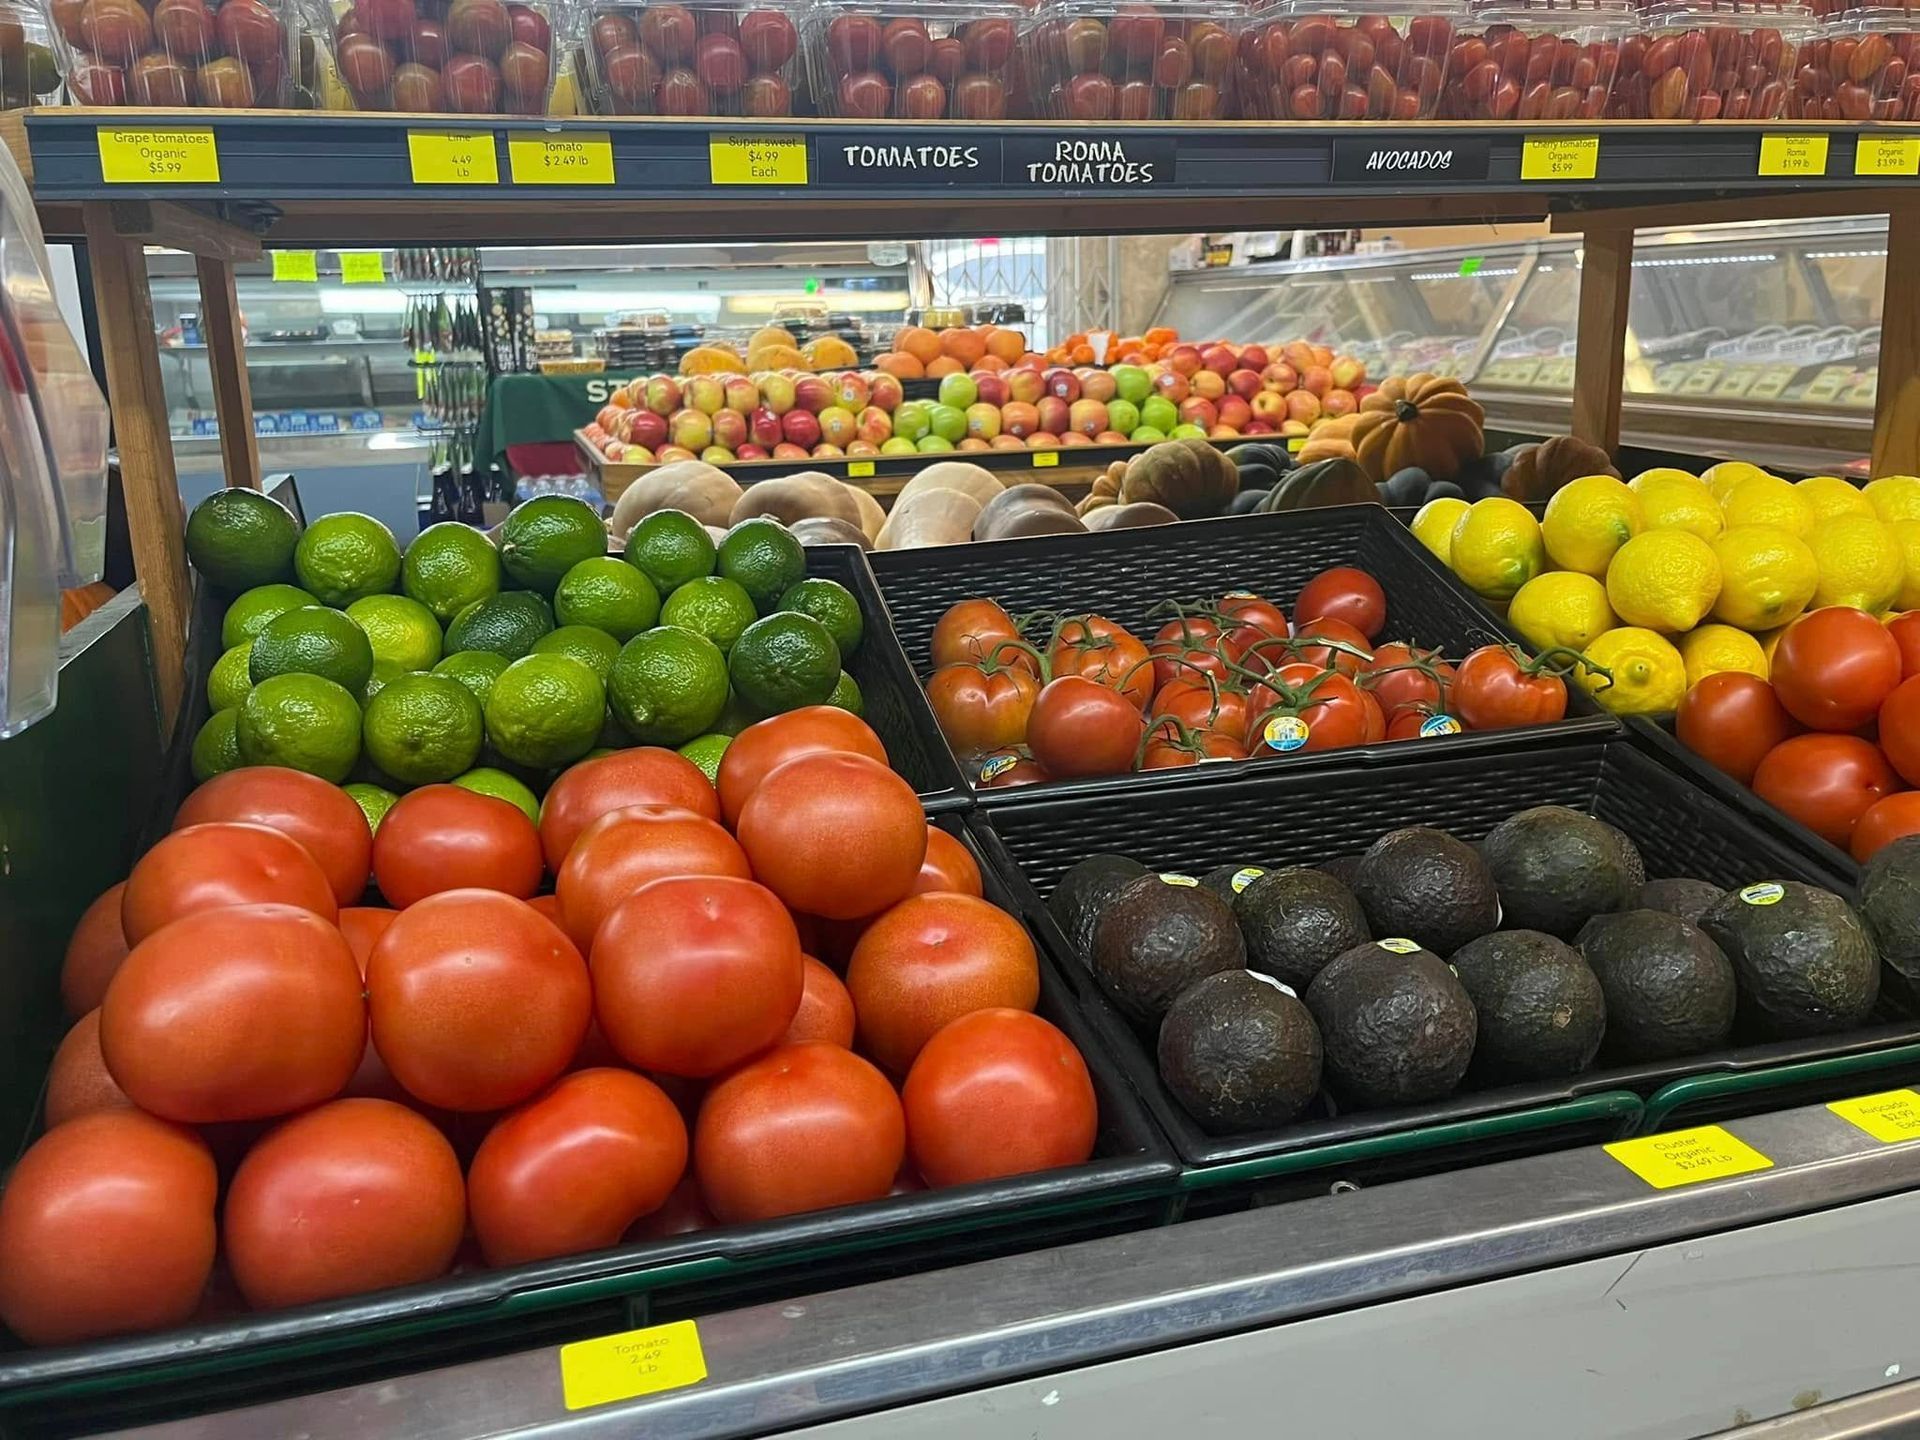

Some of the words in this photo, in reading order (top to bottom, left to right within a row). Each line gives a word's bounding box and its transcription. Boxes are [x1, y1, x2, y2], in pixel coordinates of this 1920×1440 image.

[113, 132, 149, 145] Grape
[153, 133, 209, 144] tomatoes
[728, 136, 760, 149] Super
[764, 138, 796, 148] sweet
[1532, 140, 1557, 150] Cherry
[1560, 140, 1596, 148] tomatoes
[544, 142, 583, 151] Tomato
[1055, 140, 1126, 163] ROMA
[140, 147, 187, 161] Organic
[748, 149, 779, 162] $4.99
[843, 146, 979, 168] TOMATOES
[1365, 150, 1453, 170] AVOCADOS
[1548, 151, 1578, 162] Organic
[149, 162, 182, 174] $5.99
[456, 167, 470, 177] Lb
[751, 166, 778, 178] Each
[1027, 163, 1153, 184] TOMATOES
[1859, 1101, 1909, 1114] Avocado
[1654, 1138, 1697, 1151] Cluster
[1664, 1146, 1715, 1160] Organic
[1675, 1156, 1713, 1170] $3.49
[615, 1338, 670, 1355] Tomato
